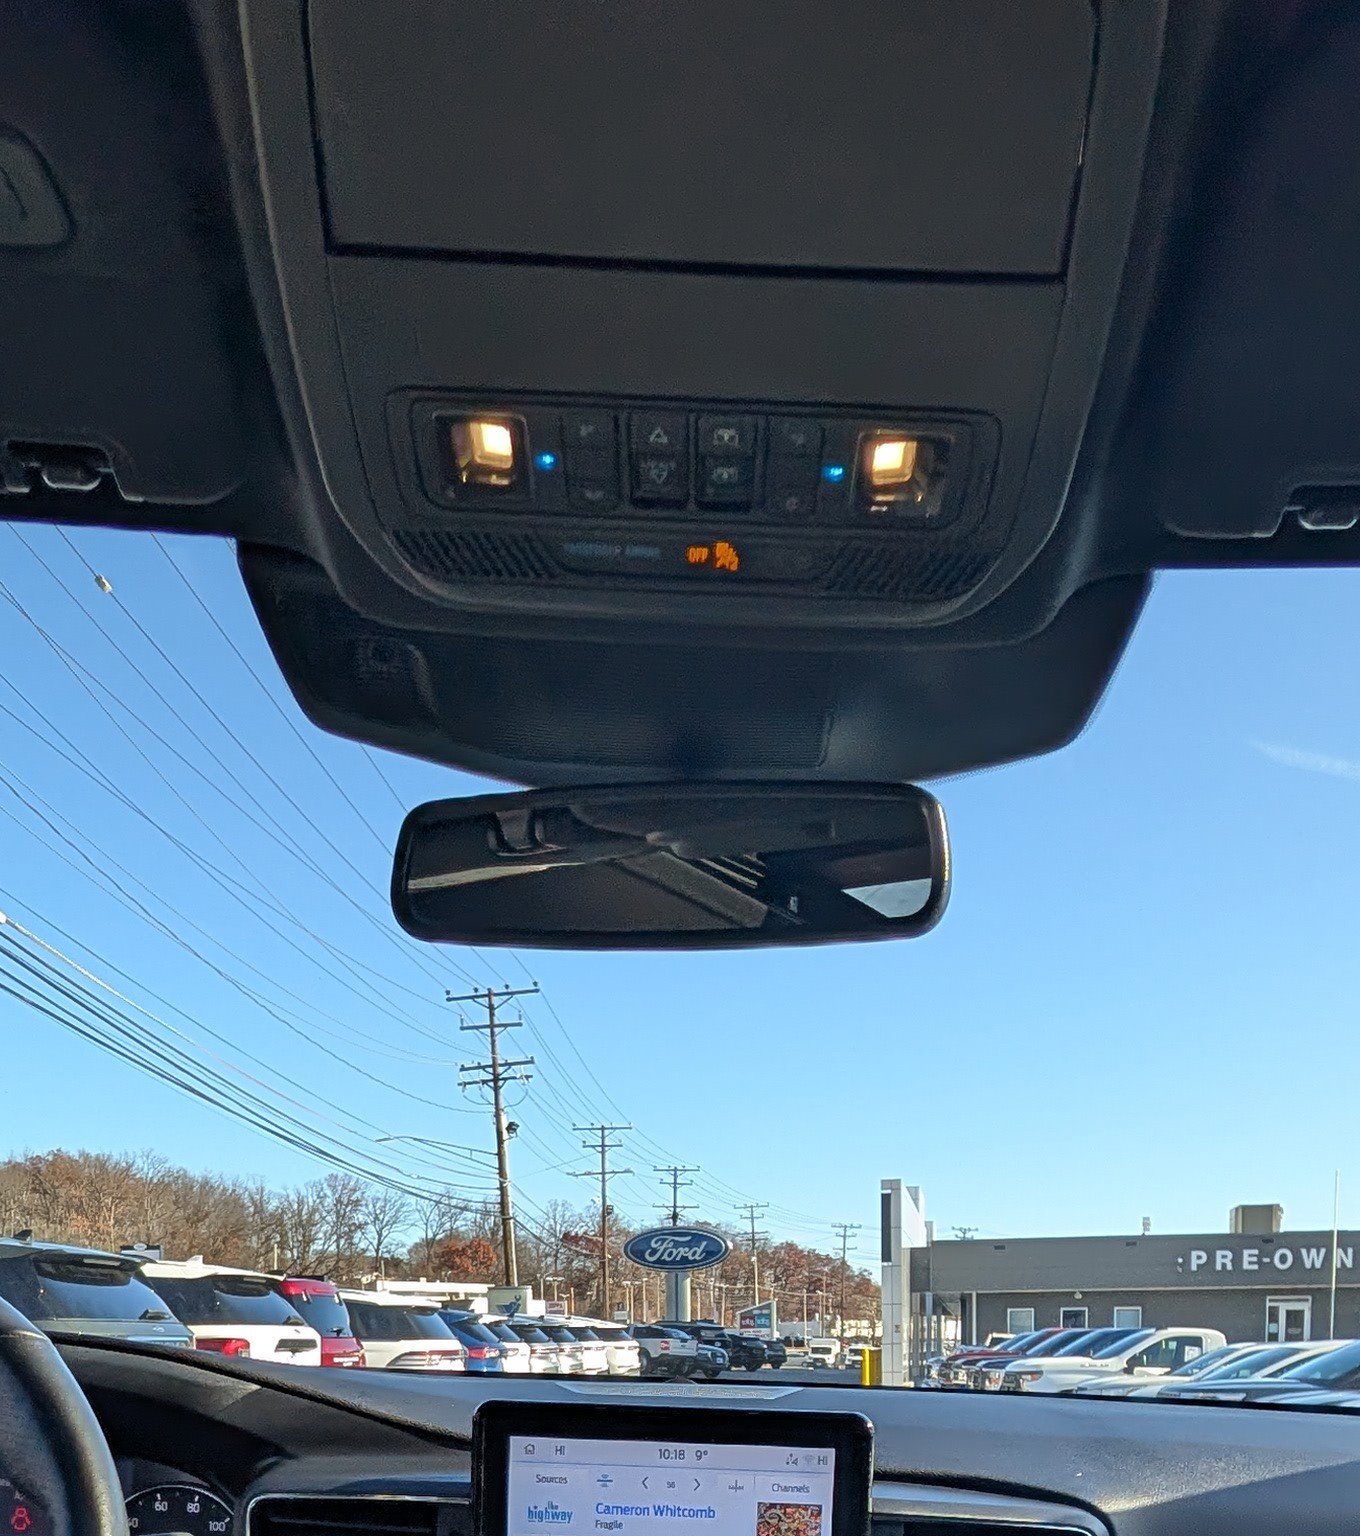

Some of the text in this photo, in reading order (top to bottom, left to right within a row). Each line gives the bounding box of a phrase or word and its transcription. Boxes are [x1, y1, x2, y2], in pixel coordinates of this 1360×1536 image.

[687, 546, 709, 563] OFF
[643, 1234, 708, 1262] Ford
[658, 1448, 686, 1460] 10:18
[535, 1474, 568, 1485] Sources
[771, 1483, 810, 1494] Channels
[154, 1501, 168, 1512] 60
[186, 1503, 201, 1514] 80
[595, 1503, 716, 1518] Cameron Whitcomb
[527, 1504, 573, 1524] highway
[209, 1521, 227, 1532] 100
[595, 1520, 624, 1530] Fragile
